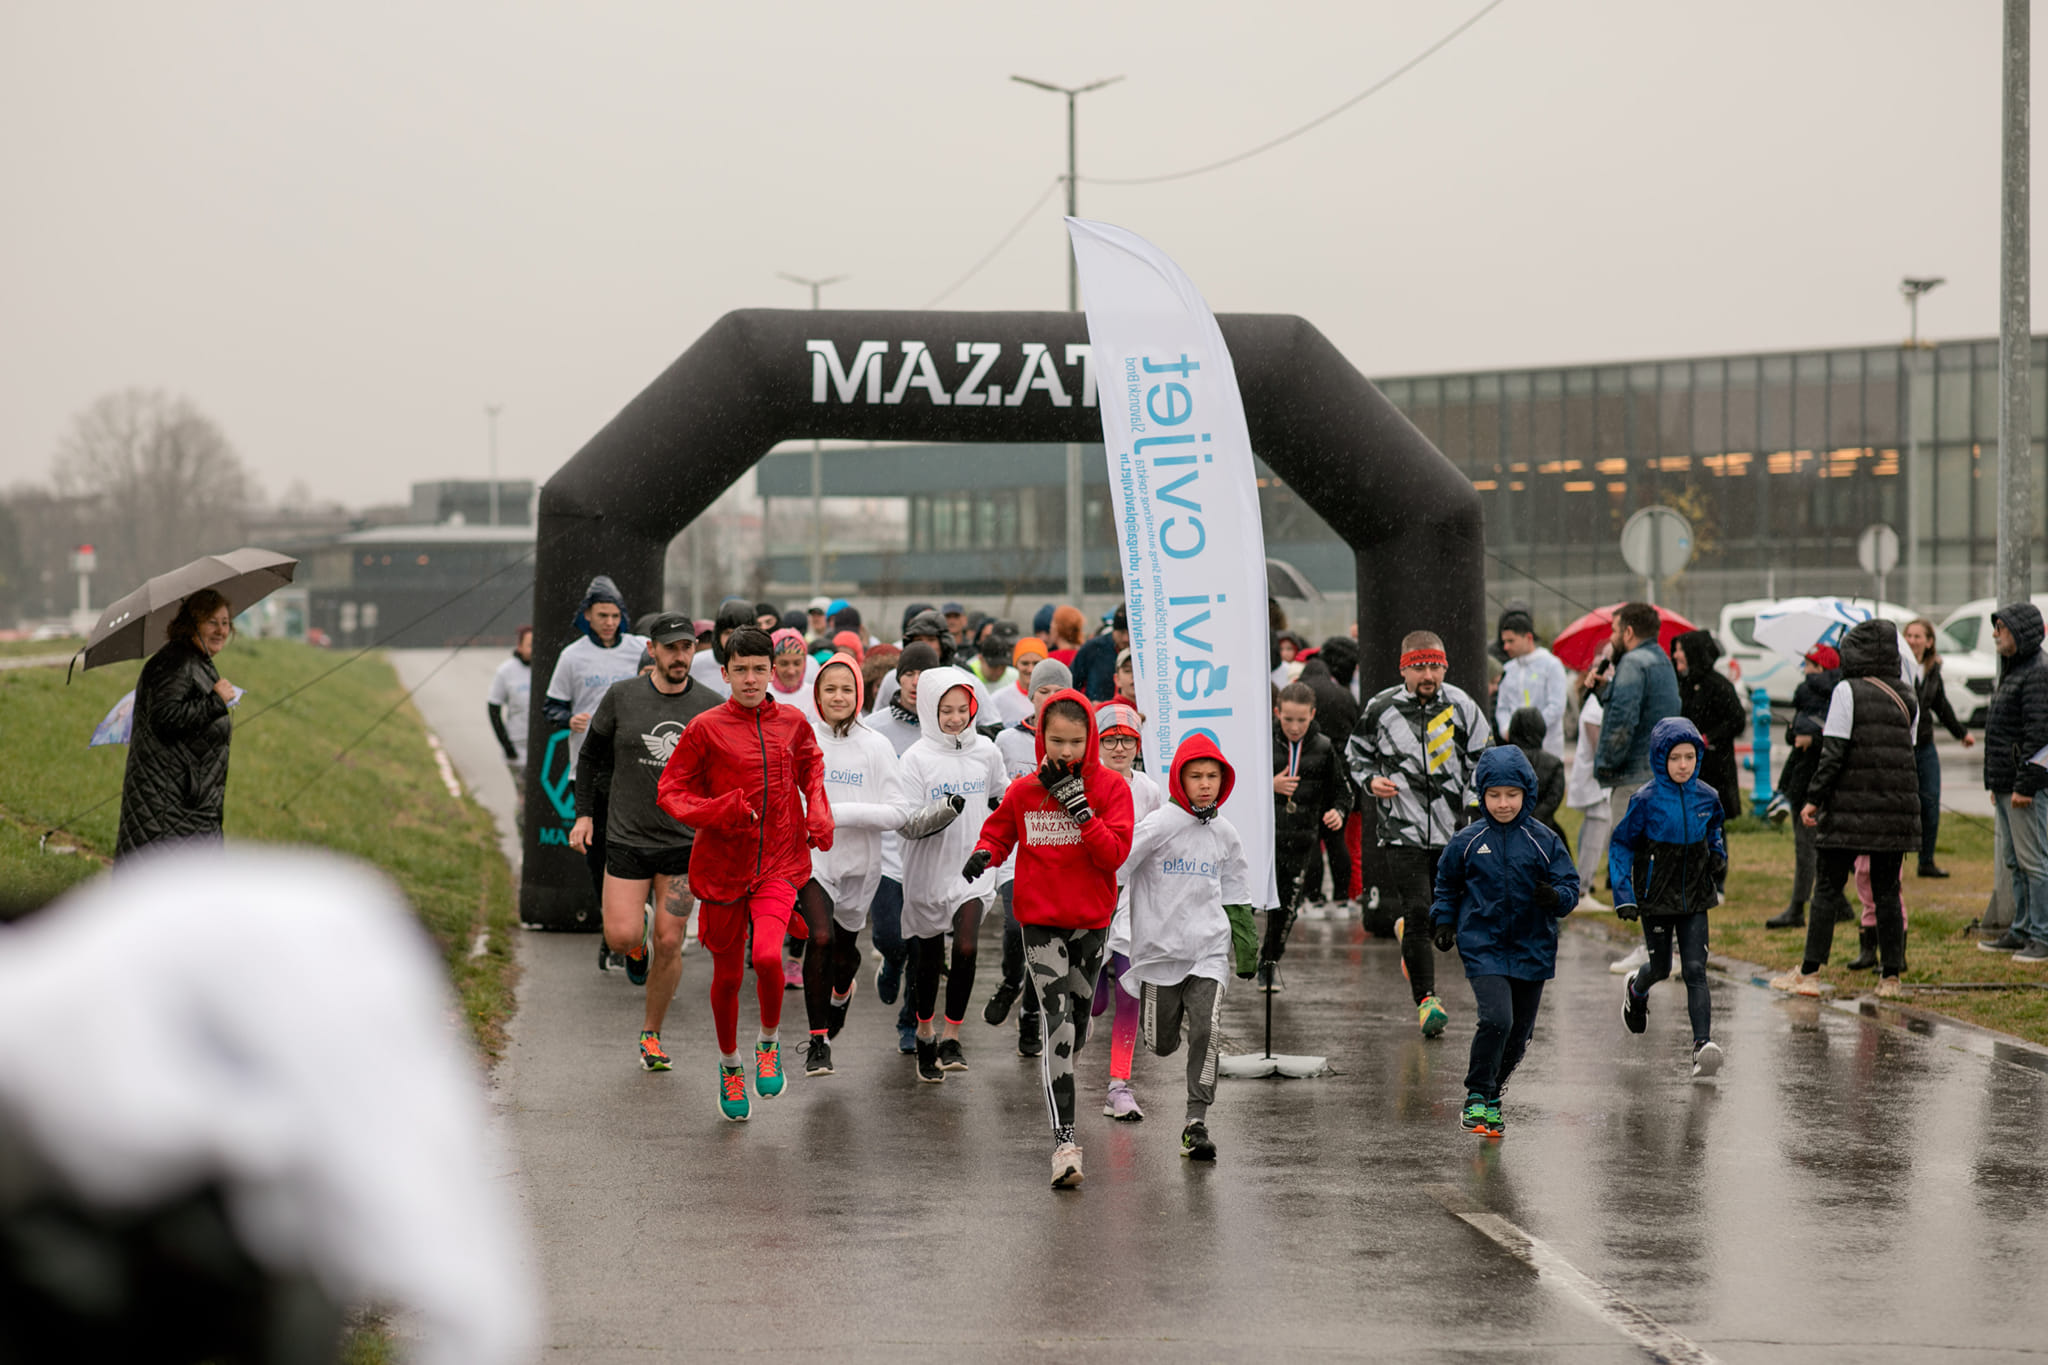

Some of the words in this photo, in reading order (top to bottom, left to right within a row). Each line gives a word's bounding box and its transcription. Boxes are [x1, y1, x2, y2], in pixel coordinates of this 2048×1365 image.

[806, 339, 1098, 407] MAZAT
[830, 769, 864, 785] cvijet
[931, 779, 960, 800] plavi
[1031, 821, 1080, 832] MAZATO
[1163, 858, 1196, 874] plavi
